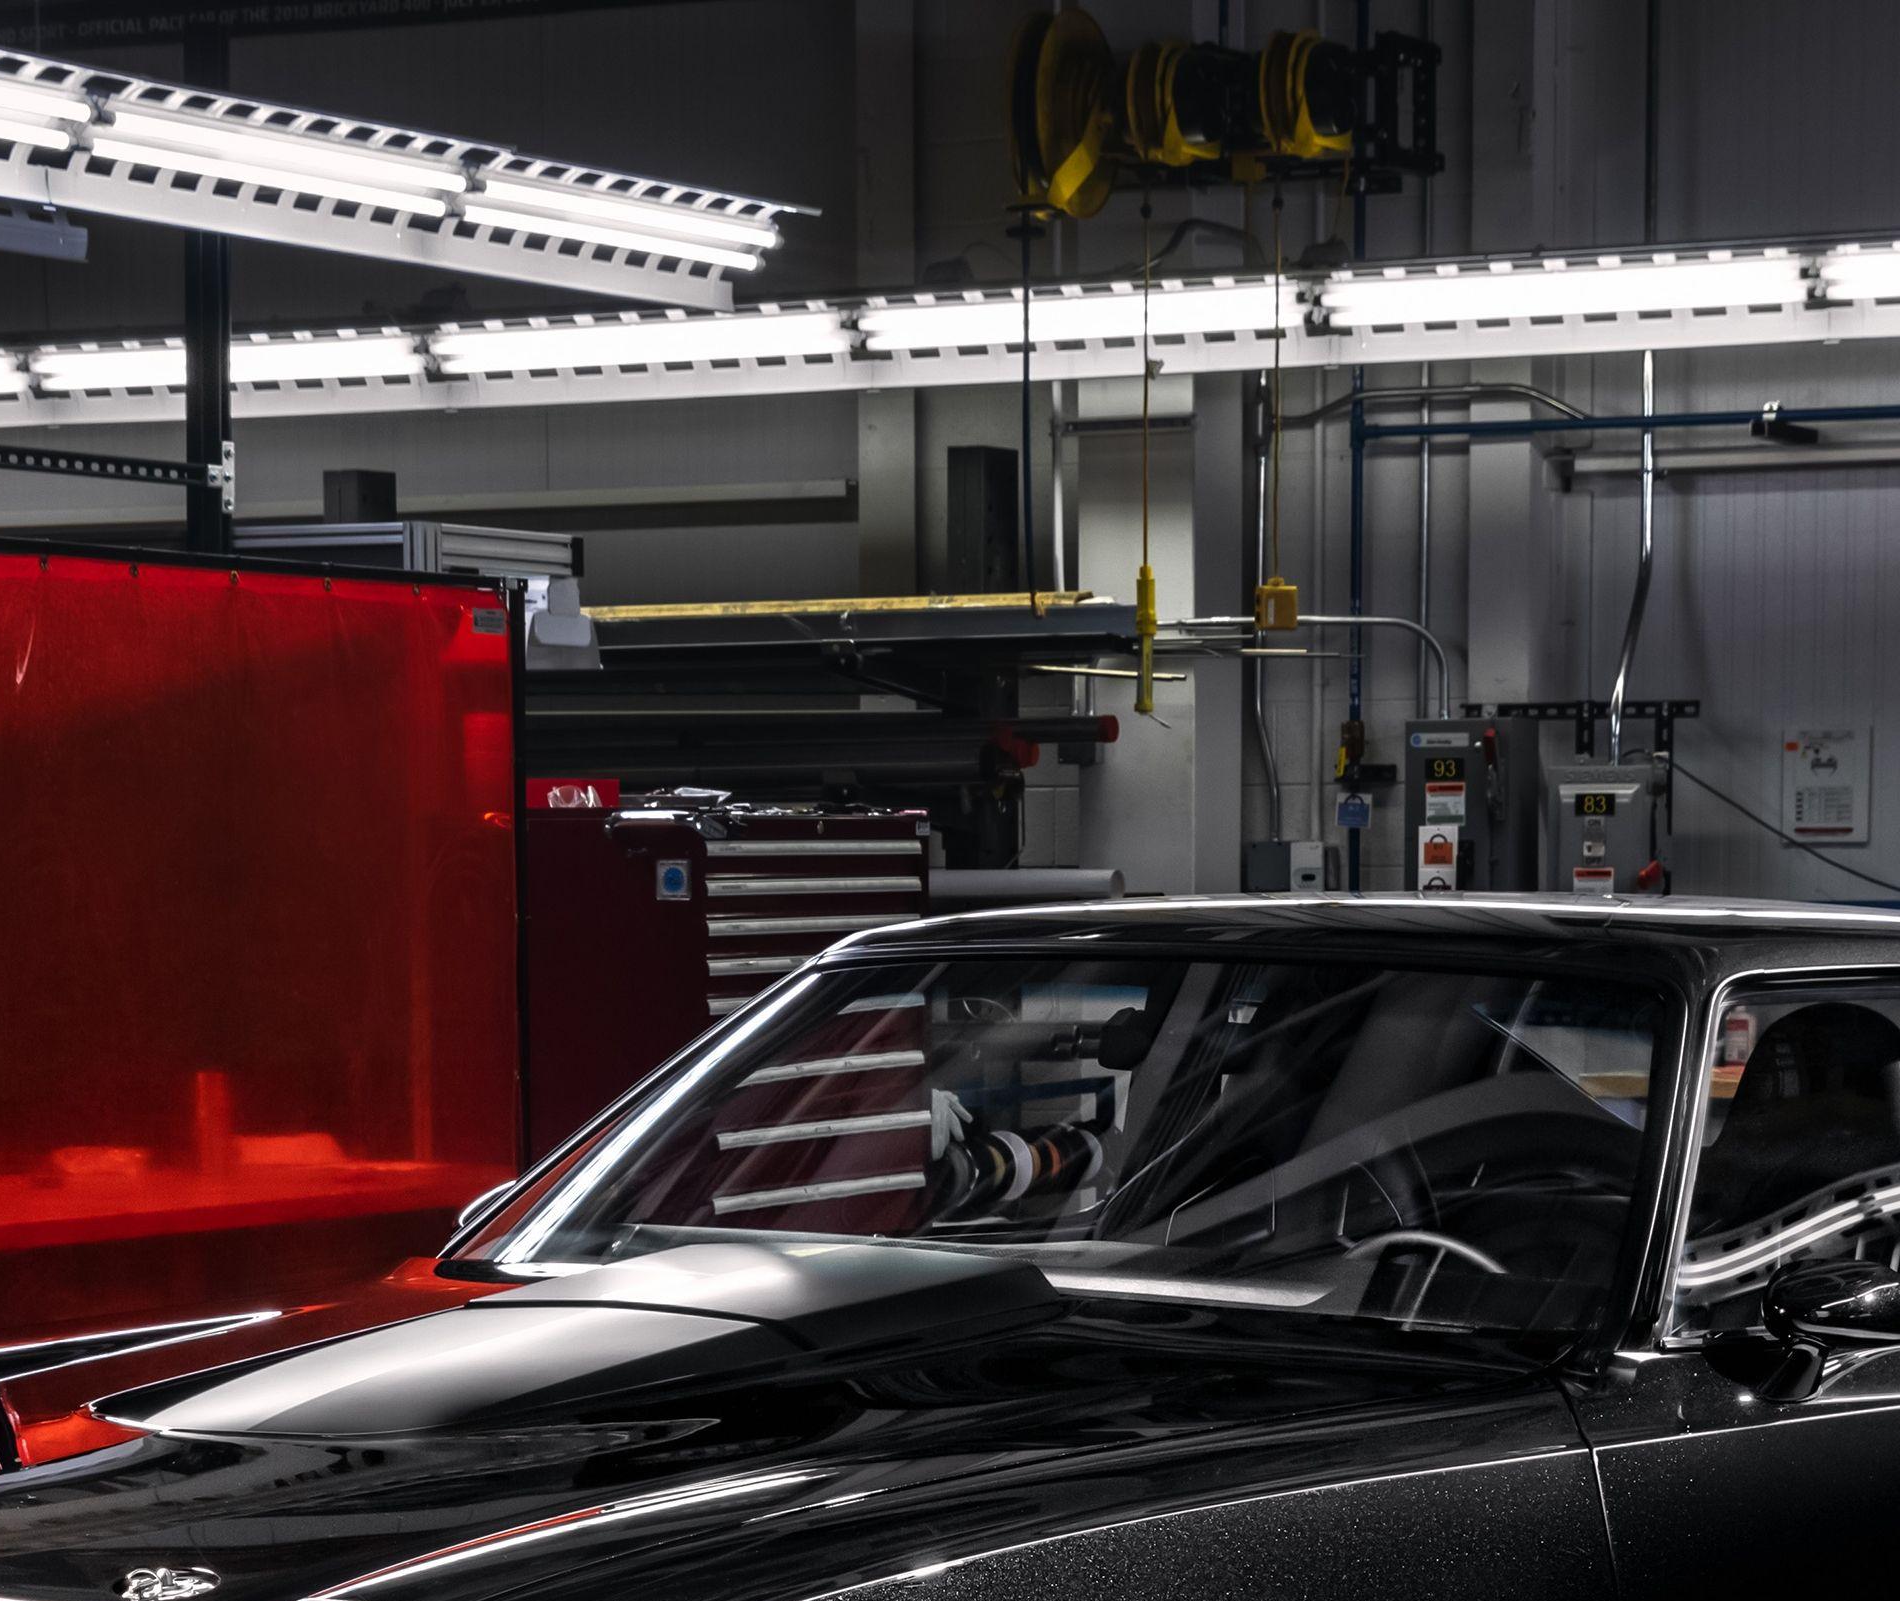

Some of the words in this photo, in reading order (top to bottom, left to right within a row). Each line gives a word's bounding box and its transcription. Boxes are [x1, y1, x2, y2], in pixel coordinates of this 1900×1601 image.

[78, 18, 145, 37] OFFICIAL
[1433, 758, 1457, 778] 93
[1583, 795, 1607, 814] 83
